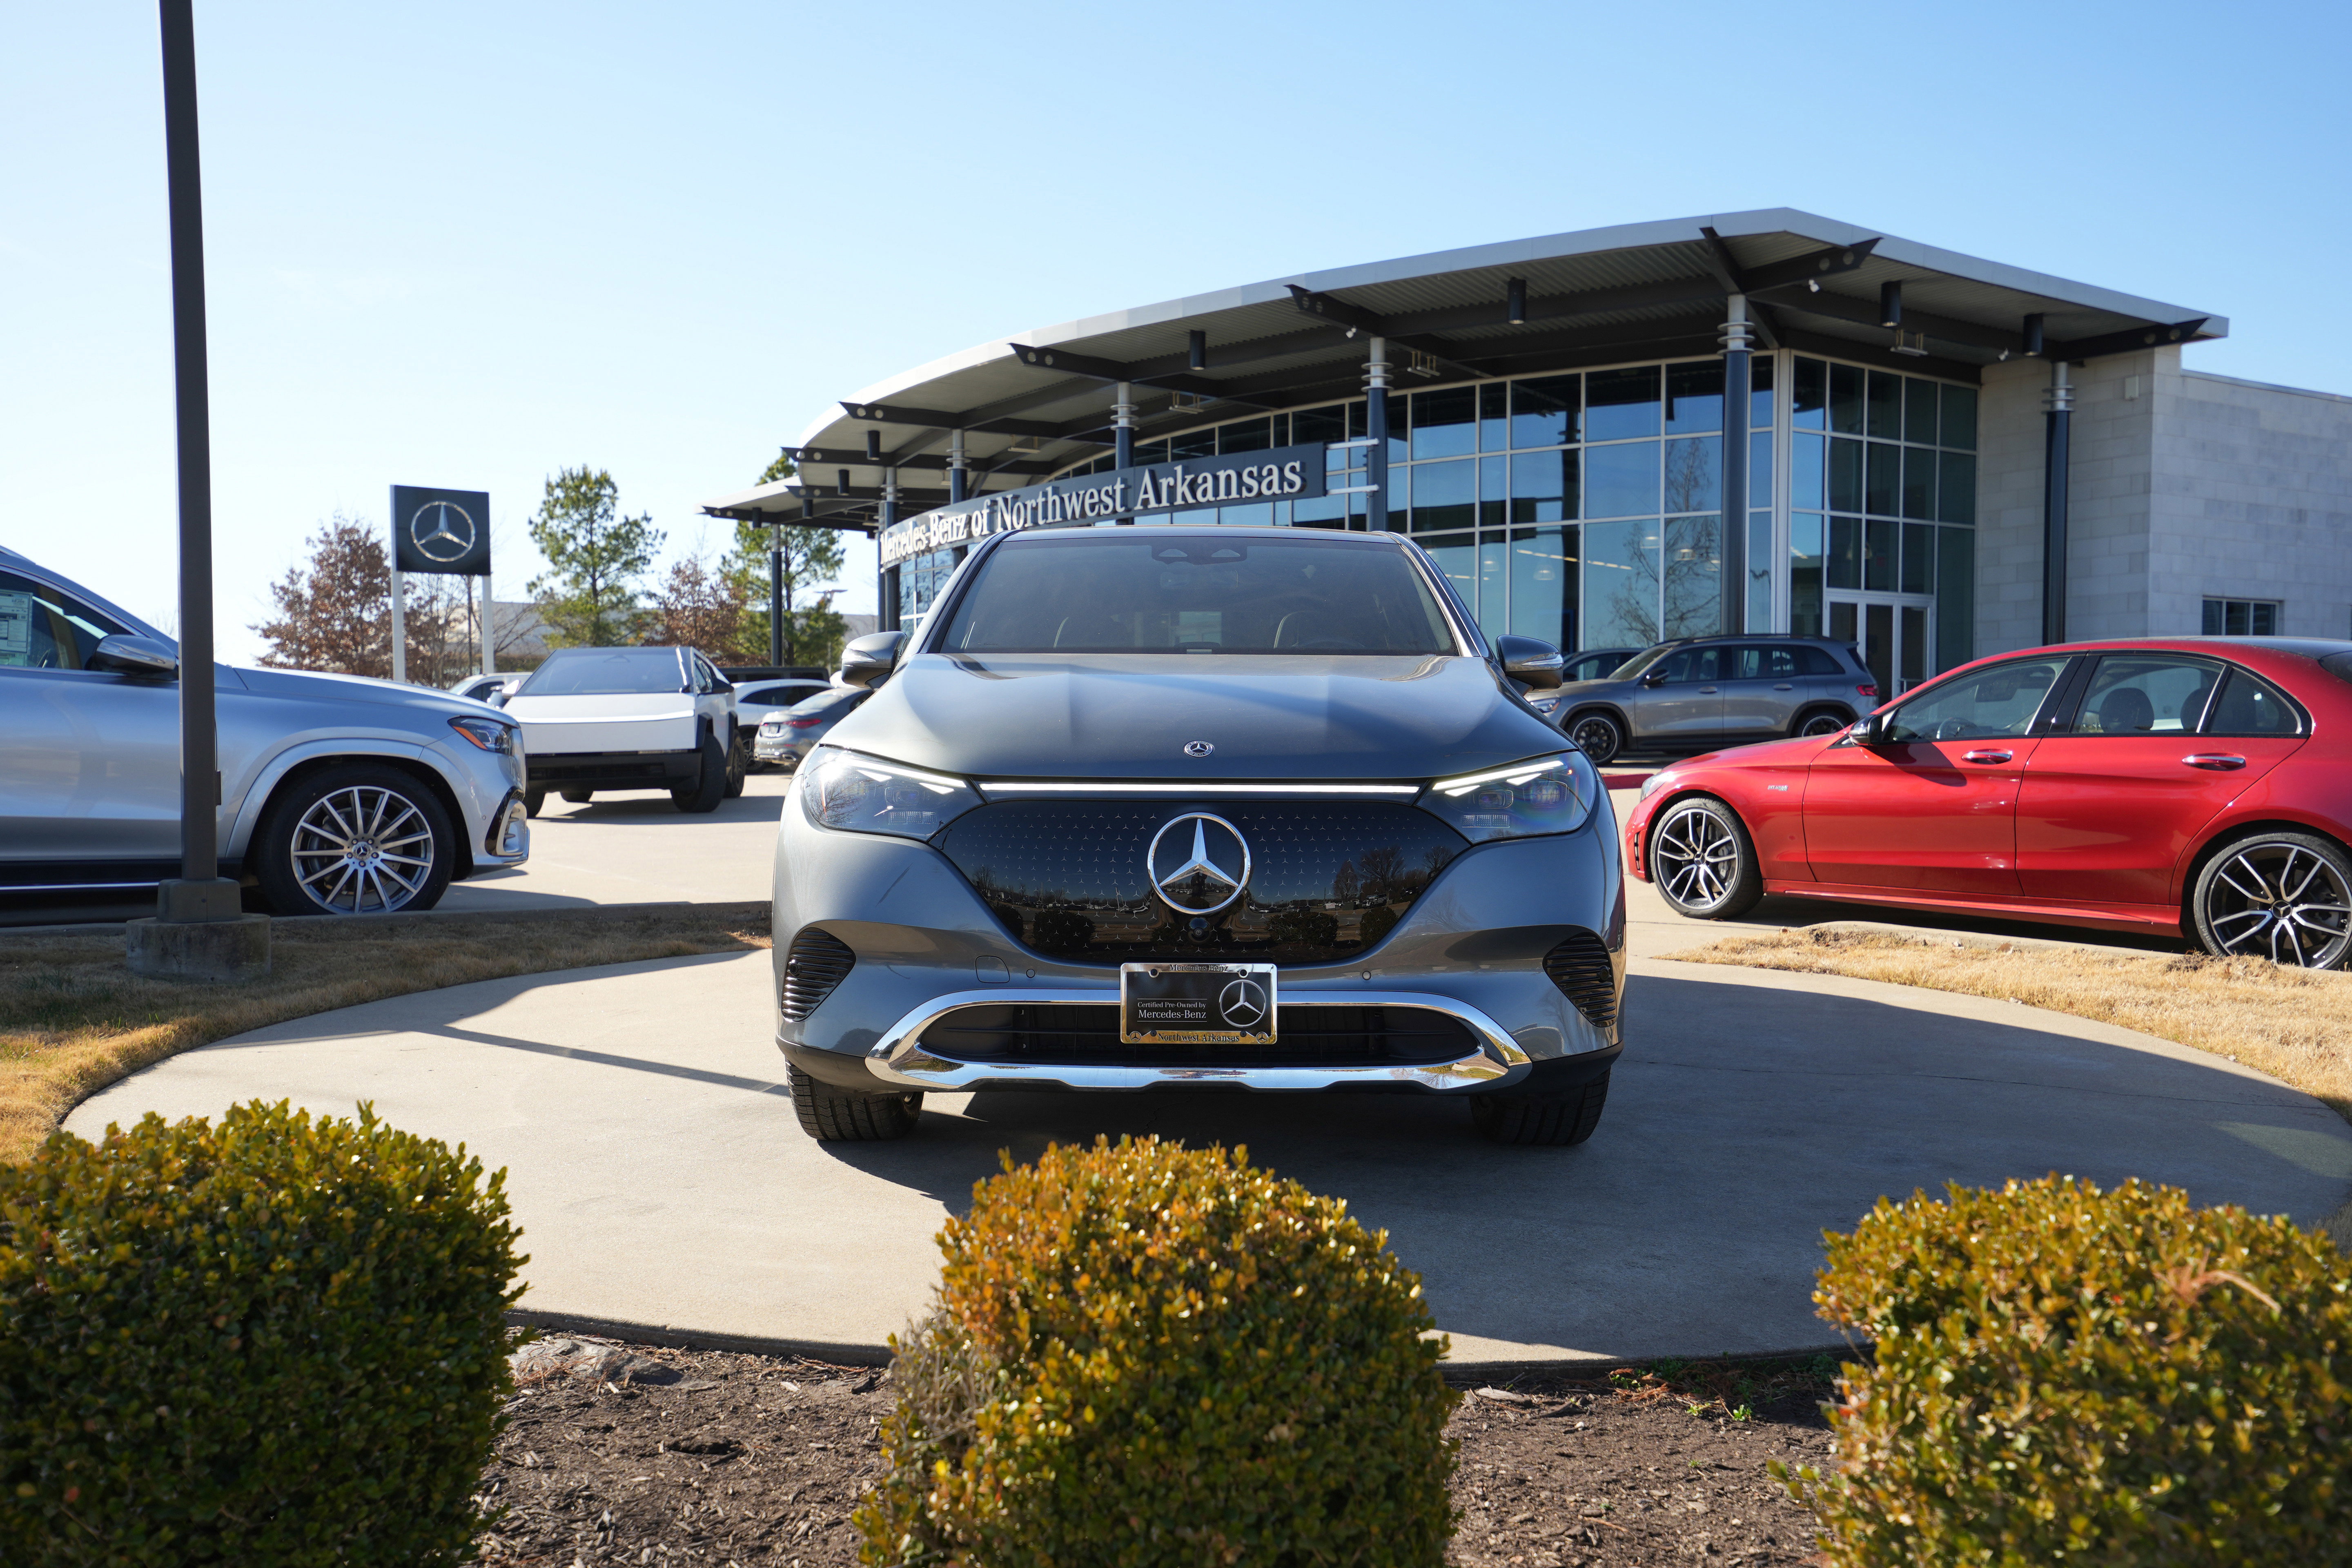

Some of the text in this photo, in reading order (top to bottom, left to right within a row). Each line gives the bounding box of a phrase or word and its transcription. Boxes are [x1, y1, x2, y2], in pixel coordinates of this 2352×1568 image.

[880, 460, 1303, 565] Mercedes-Benz of Northwest Arkansas
[1138, 1009, 1206, 1019] Mercedes-Benz
[1158, 1033, 1240, 1042] Northwest Arkansas
